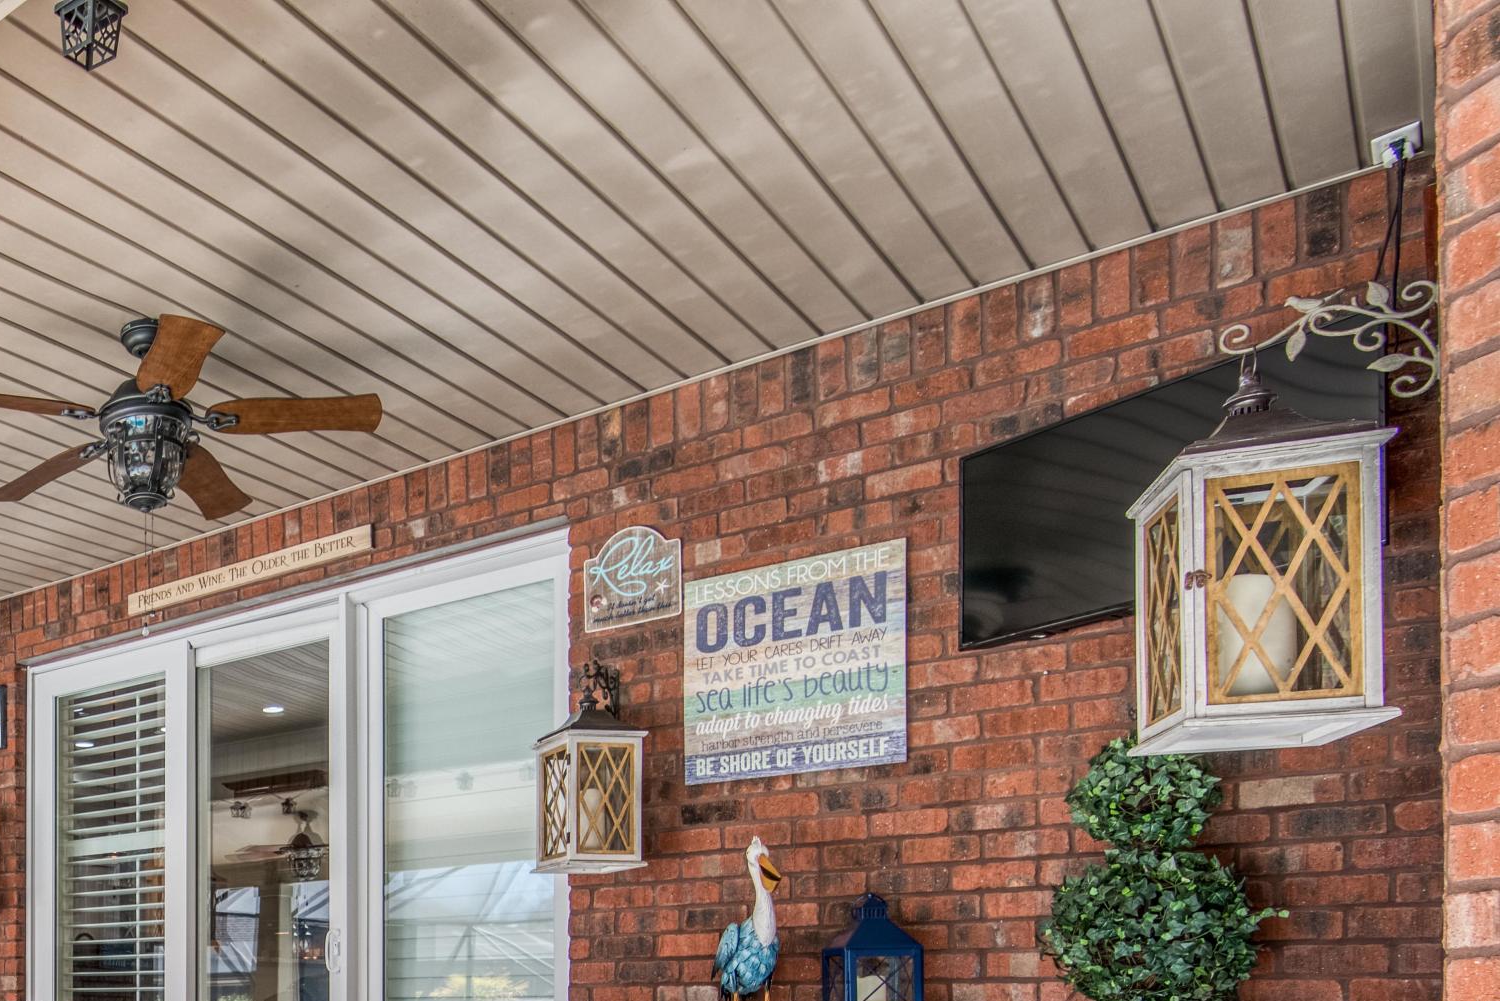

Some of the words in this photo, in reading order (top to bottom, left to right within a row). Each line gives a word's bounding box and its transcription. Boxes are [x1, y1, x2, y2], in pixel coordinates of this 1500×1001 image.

[138, 589, 172, 609] FRIENDS
[175, 581, 195, 597] AND
[198, 572, 226, 590] WINE:
[228, 565, 248, 582] THE
[251, 555, 290, 575] OLDER
[290, 549, 310, 564] THE
[314, 535, 357, 559] BETTER
[589, 534, 674, 597] Relax
[695, 568, 781, 605] LESSONS
[787, 556, 847, 586] FROM
[852, 546, 891, 572] THE
[695, 570, 887, 654] OCEAN
[696, 656, 714, 672] LET
[723, 649, 758, 667] YOUR
[764, 640, 804, 660] CARES
[810, 634, 843, 652] DRIFT
[851, 627, 888, 646] AWAY
[703, 666, 745, 686] TAKE
[749, 659, 789, 677] TIME
[794, 653, 817, 671] TO
[822, 644, 881, 667] COAST
[696, 686, 733, 714] sea
[743, 676, 794, 708] life's
[804, 661, 889, 698] beauty
[695, 715, 741, 740] adapt
[744, 713, 760, 730] to
[764, 700, 844, 730] changing
[847, 693, 890, 716] tides
[701, 737, 741, 752] harbor
[742, 728, 794, 748] strength
[797, 725, 820, 739] and
[823, 719, 884, 738] persevere
[696, 757, 716, 777] BE
[719, 750, 772, 774] SHORE
[776, 748, 799, 768] OF
[802, 736, 891, 765] YOURSELF
